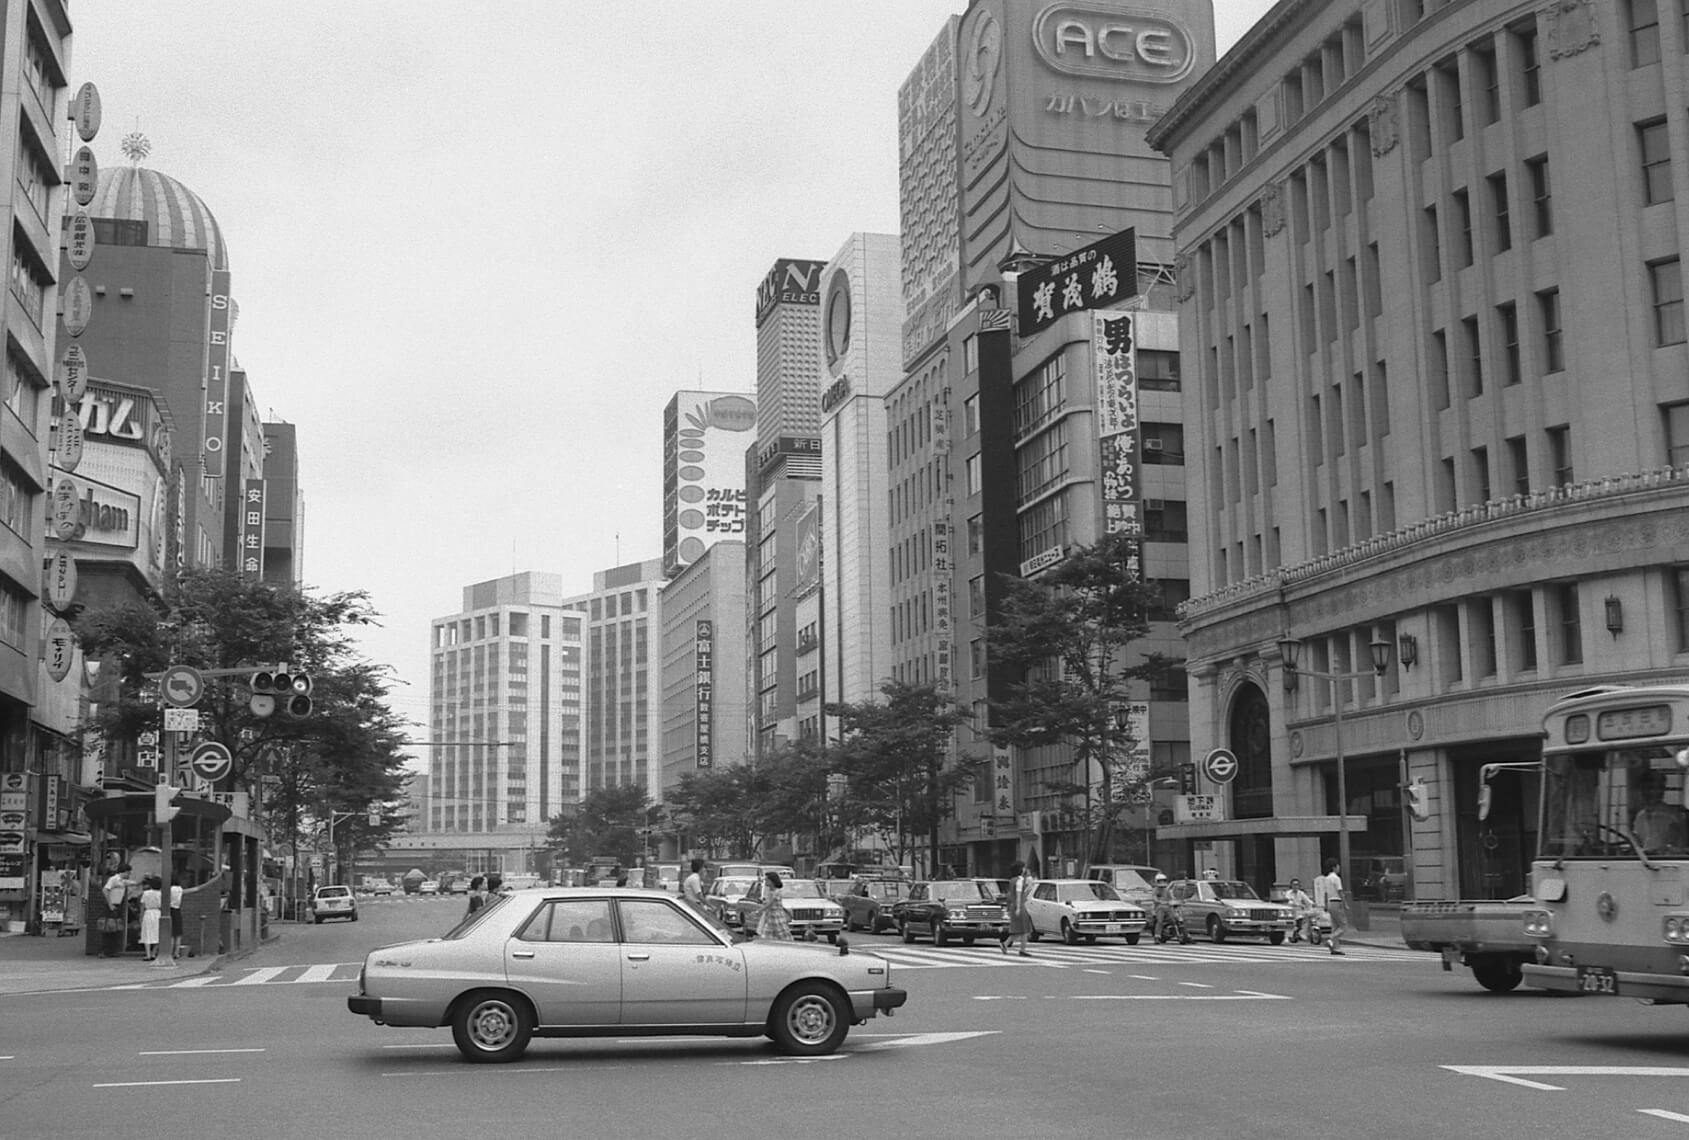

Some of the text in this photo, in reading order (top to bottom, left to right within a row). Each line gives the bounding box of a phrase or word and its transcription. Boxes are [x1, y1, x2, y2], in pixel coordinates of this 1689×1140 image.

[1056, 21, 1173, 65] ACE
[1033, 254, 1118, 323] 賀茂鶴
[206, 295, 228, 451] SEIKO
[1103, 316, 1135, 428] 男はつらいよ
[245, 488, 262, 573] 安田生命
[706, 503, 746, 517] ポテト
[697, 639, 712, 701] 富士銀行
